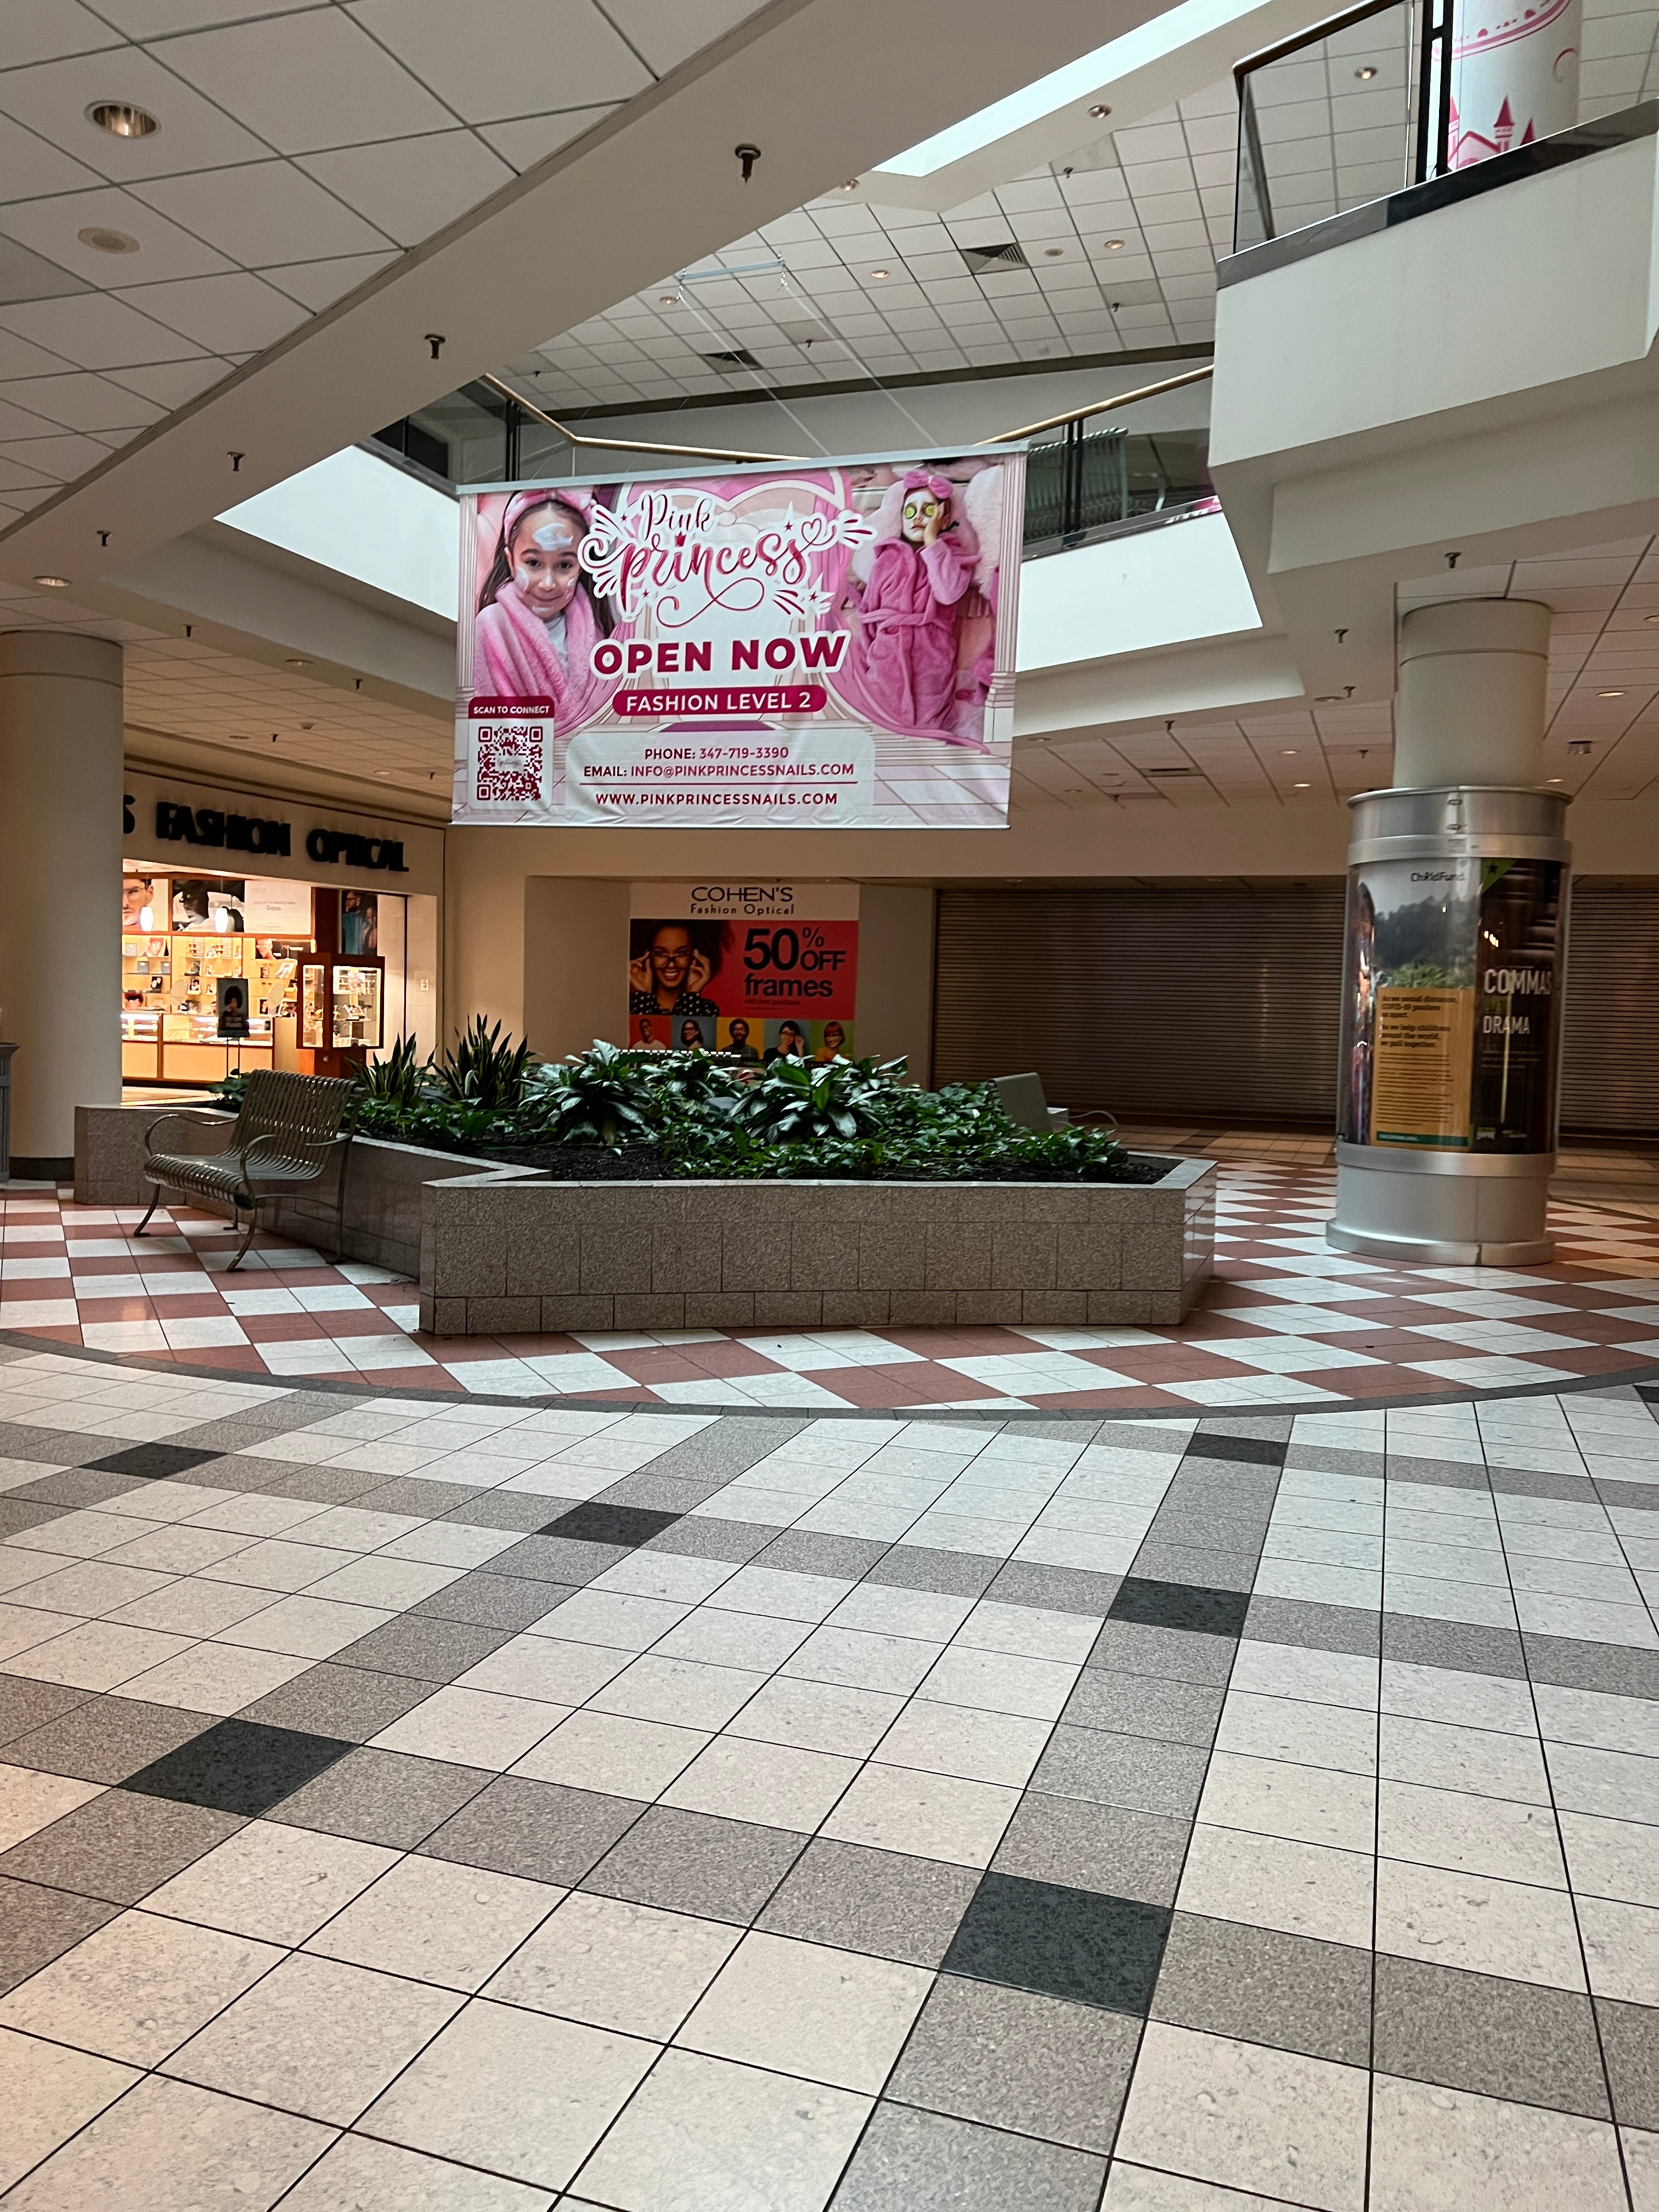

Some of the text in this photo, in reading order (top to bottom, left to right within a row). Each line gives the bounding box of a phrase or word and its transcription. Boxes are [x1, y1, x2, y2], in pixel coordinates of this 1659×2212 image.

[641, 494, 712, 540] Pink
[594, 636, 846, 675] OPEN NOW
[473, 706, 550, 714] SCAN TO CONNECT
[627, 691, 811, 712] FASHION LEVEL 2
[645, 747, 789, 759] PHONE: 347-719-3390
[584, 764, 854, 778] EMAIL: INFO@PINKPRINCESSNAILS.COM
[596, 793, 838, 805] WWW.PINKPRINCESSNAILS.COM
[156, 802, 291, 856] FASHION
[306, 828, 410, 872] OPTICAL
[691, 887, 793, 902] COHEN'S
[690, 903, 794, 916] Fashion Optical
[800, 950, 847, 970] OFF
[744, 973, 833, 997] frames
[1484, 969, 1551, 995] COMMAS
[1483, 1015, 1531, 1034] DRAMA
